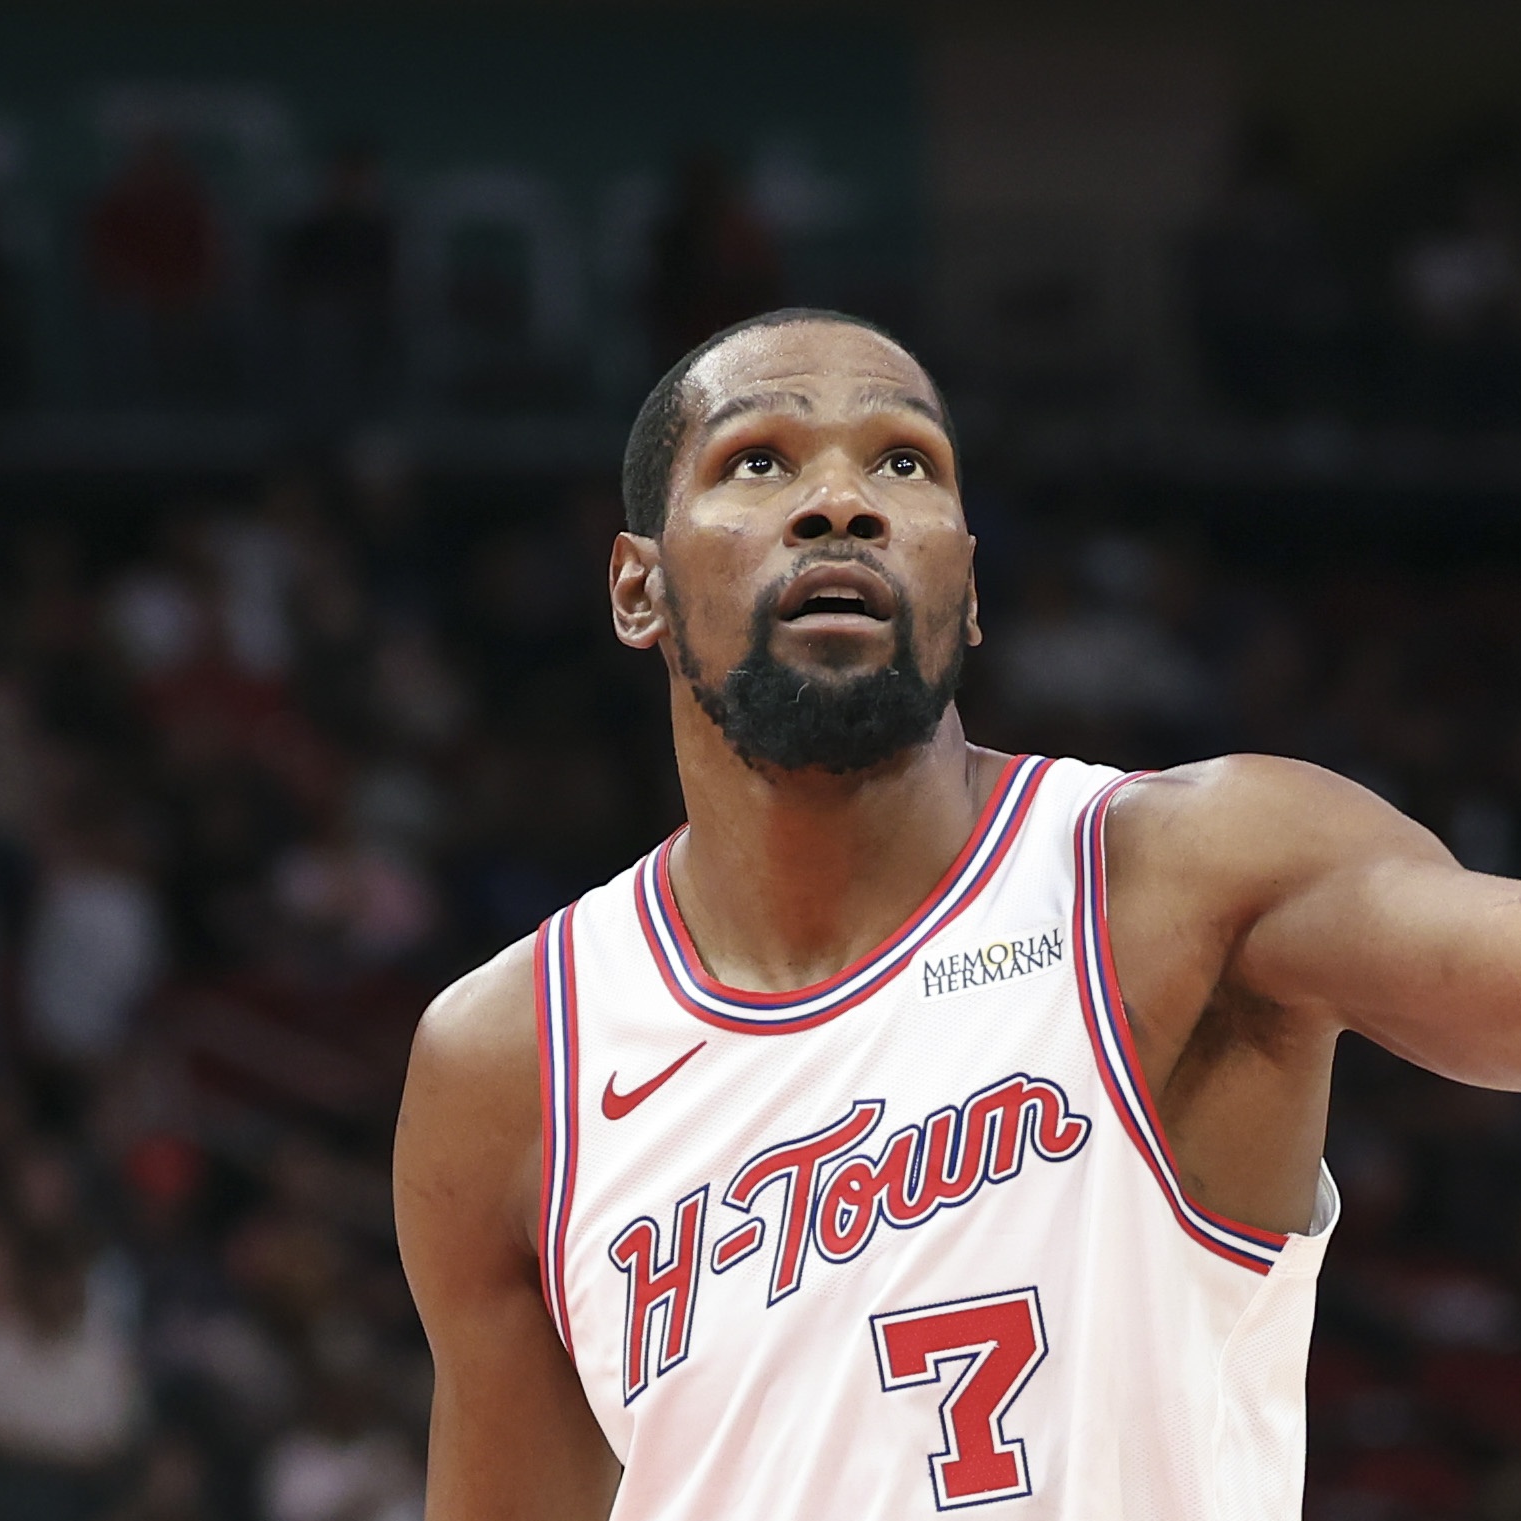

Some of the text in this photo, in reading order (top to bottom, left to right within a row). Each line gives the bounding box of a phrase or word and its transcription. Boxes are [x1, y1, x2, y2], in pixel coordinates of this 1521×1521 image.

[923, 927, 1064, 980] MEMORIAL
[924, 942, 1063, 998] HERMANN
[608, 1072, 1092, 1408] H-Town
[870, 1286, 1049, 1512] 7
